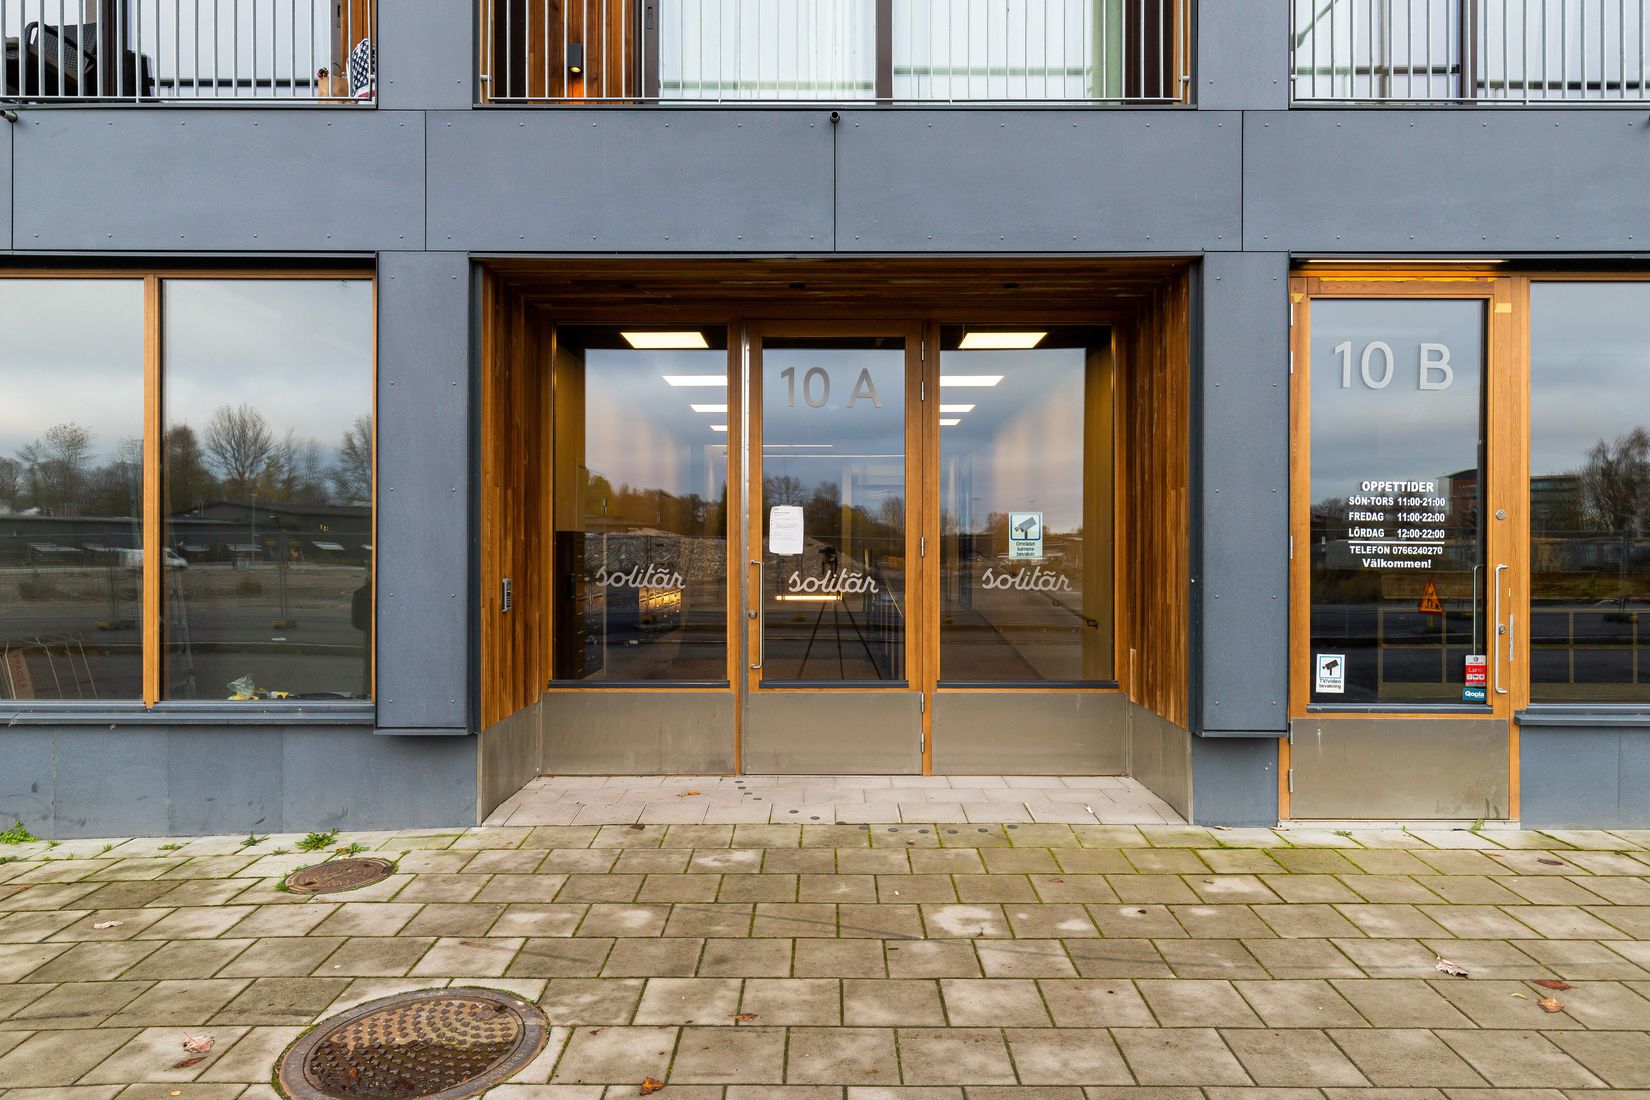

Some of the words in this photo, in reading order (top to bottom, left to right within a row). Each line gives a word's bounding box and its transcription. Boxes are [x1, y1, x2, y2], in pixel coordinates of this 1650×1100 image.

[1333, 340, 1394, 390] 10
[1419, 342, 1454, 390] B
[780, 366, 831, 408] 10
[846, 367, 882, 408] A
[1397, 497, 1446, 507] 11:00-21:00
[1348, 512, 1385, 521] FREDAG
[1397, 512, 1446, 522] 11:00-22:00
[1348, 526, 1385, 538] LÖRDAG
[1397, 528, 1446, 539] 12:00-22:00
[1349, 546, 1391, 554] TELEFON
[1392, 546, 1443, 555] 0766240270
[1361, 558, 1432, 568] Välkommen!
[1464, 690, 1485, 698] Qopla
